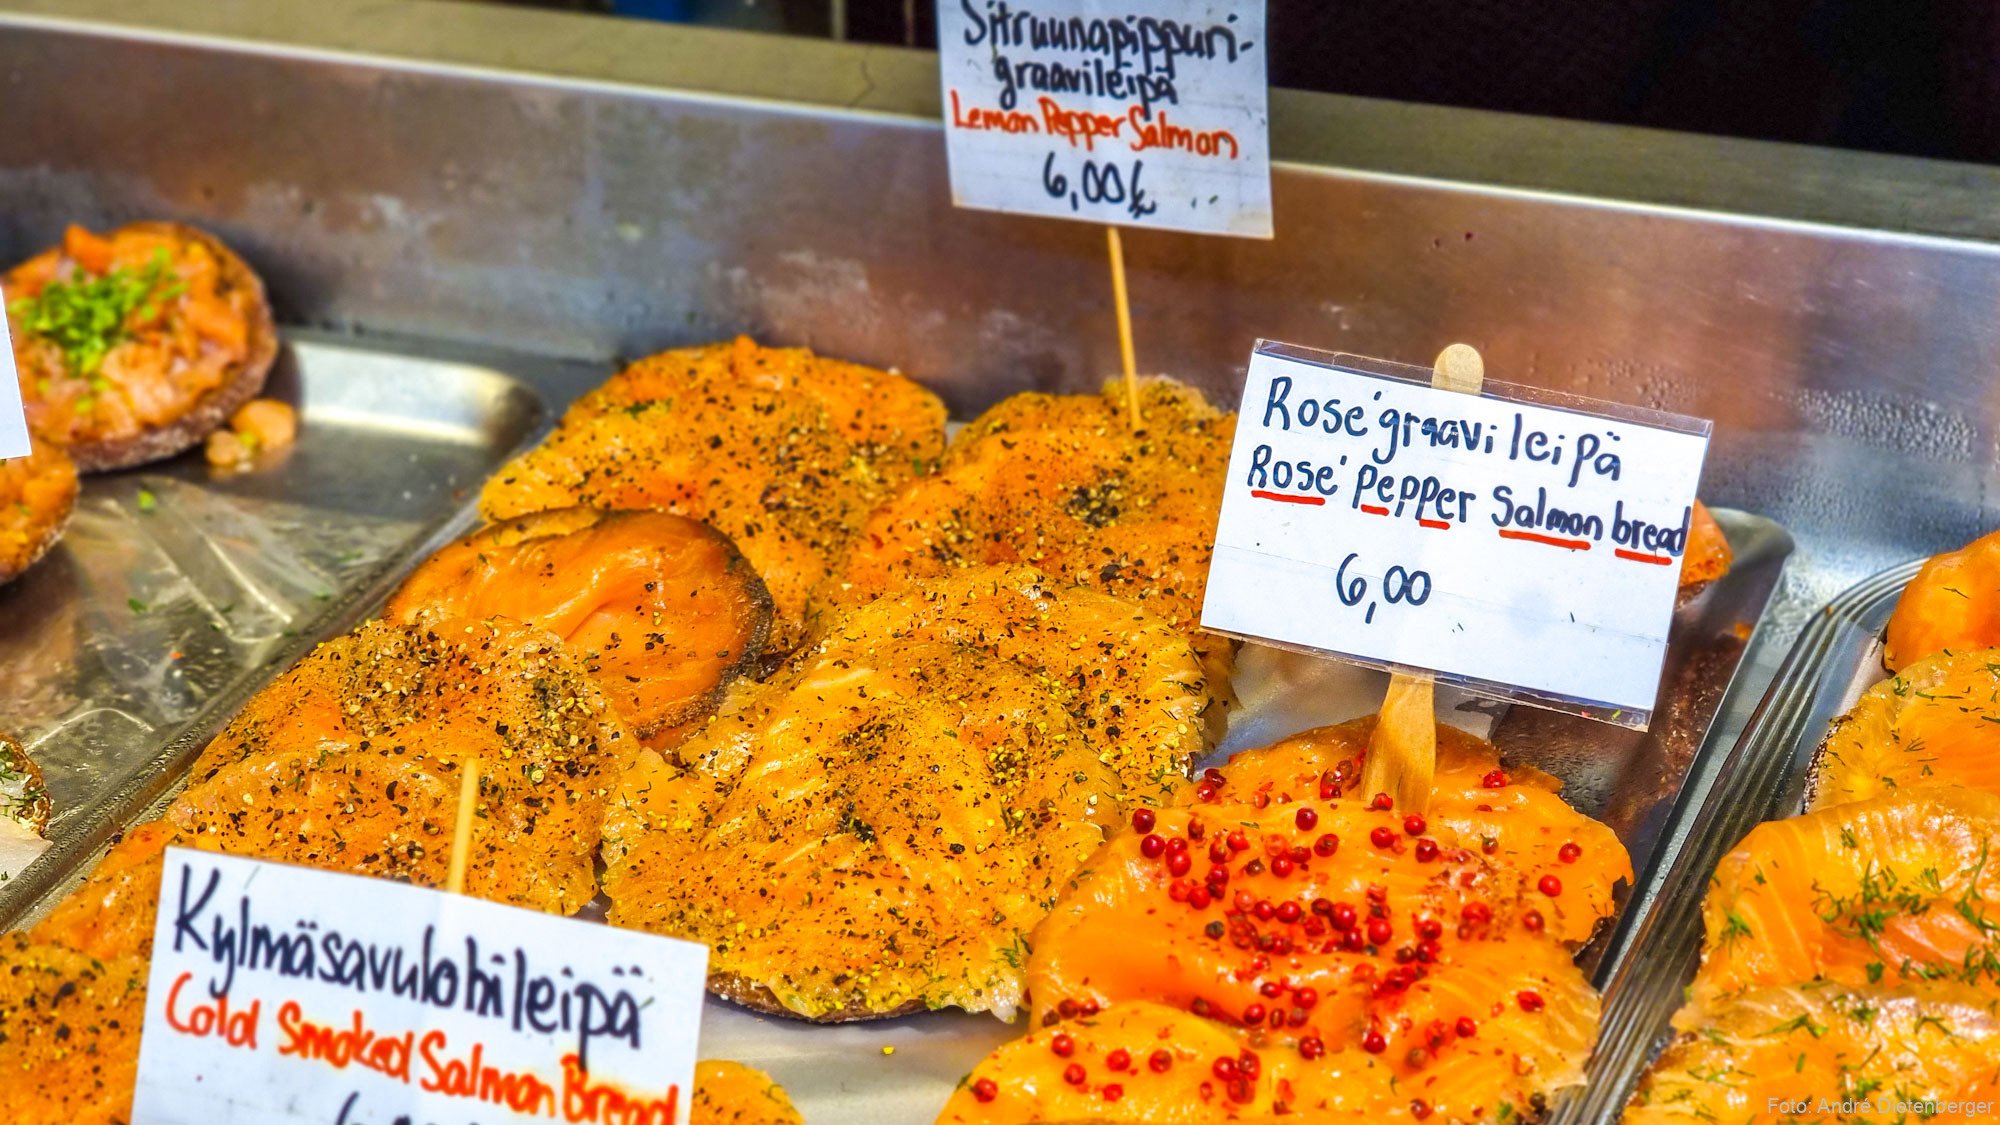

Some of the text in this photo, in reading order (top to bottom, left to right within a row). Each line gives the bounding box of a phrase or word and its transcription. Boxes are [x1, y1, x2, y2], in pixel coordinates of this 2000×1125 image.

[950, 89, 1239, 160] Lemon Pepper Salmon
[1491, 485, 1604, 541] Salmon
[1611, 500, 1692, 557] bread
[1336, 553, 1432, 624] 6,00
[166, 972, 261, 1050] Cold
[278, 1001, 414, 1084] Smoked
[420, 1030, 556, 1118] Salmon
